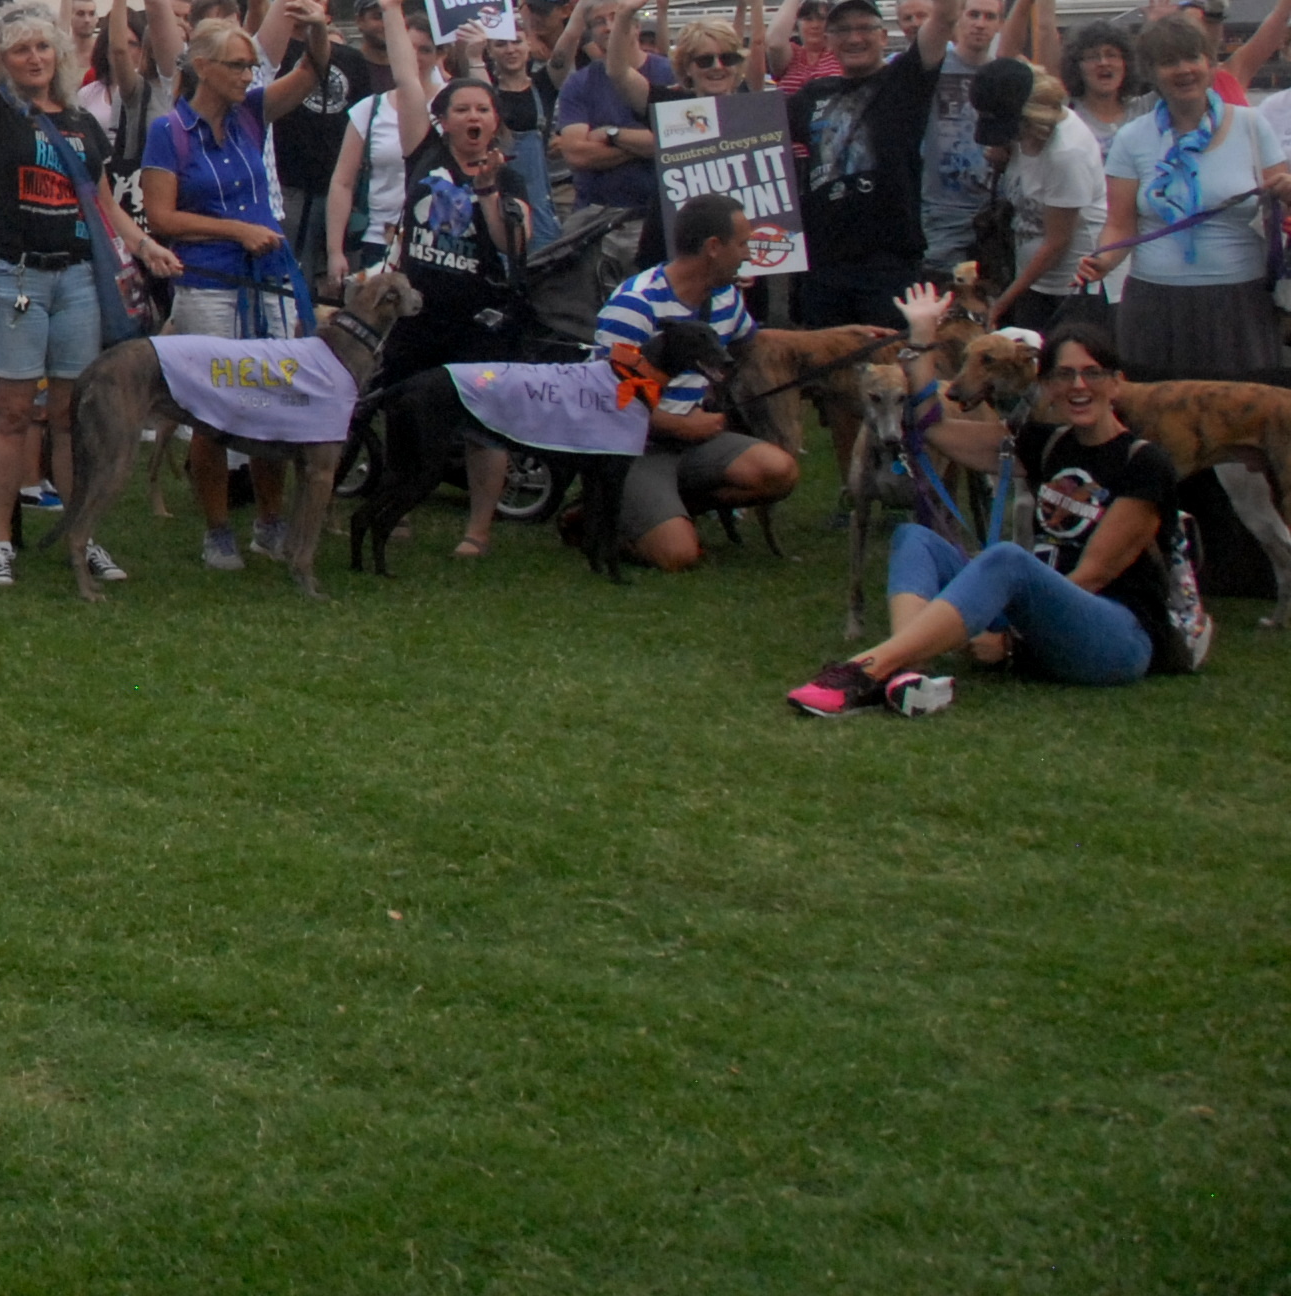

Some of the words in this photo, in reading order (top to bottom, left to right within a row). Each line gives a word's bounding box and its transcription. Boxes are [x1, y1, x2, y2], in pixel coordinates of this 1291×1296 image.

[661, 144, 717, 164] Gumtree
[719, 136, 759, 152] Greys
[760, 131, 784, 143] say
[23, 169, 56, 197] MUST
[662, 153, 749, 202] SHUT
[753, 146, 786, 183] IT
[210, 357, 299, 388] HELP
[524, 380, 562, 405] WE
[579, 387, 614, 414] DIE
